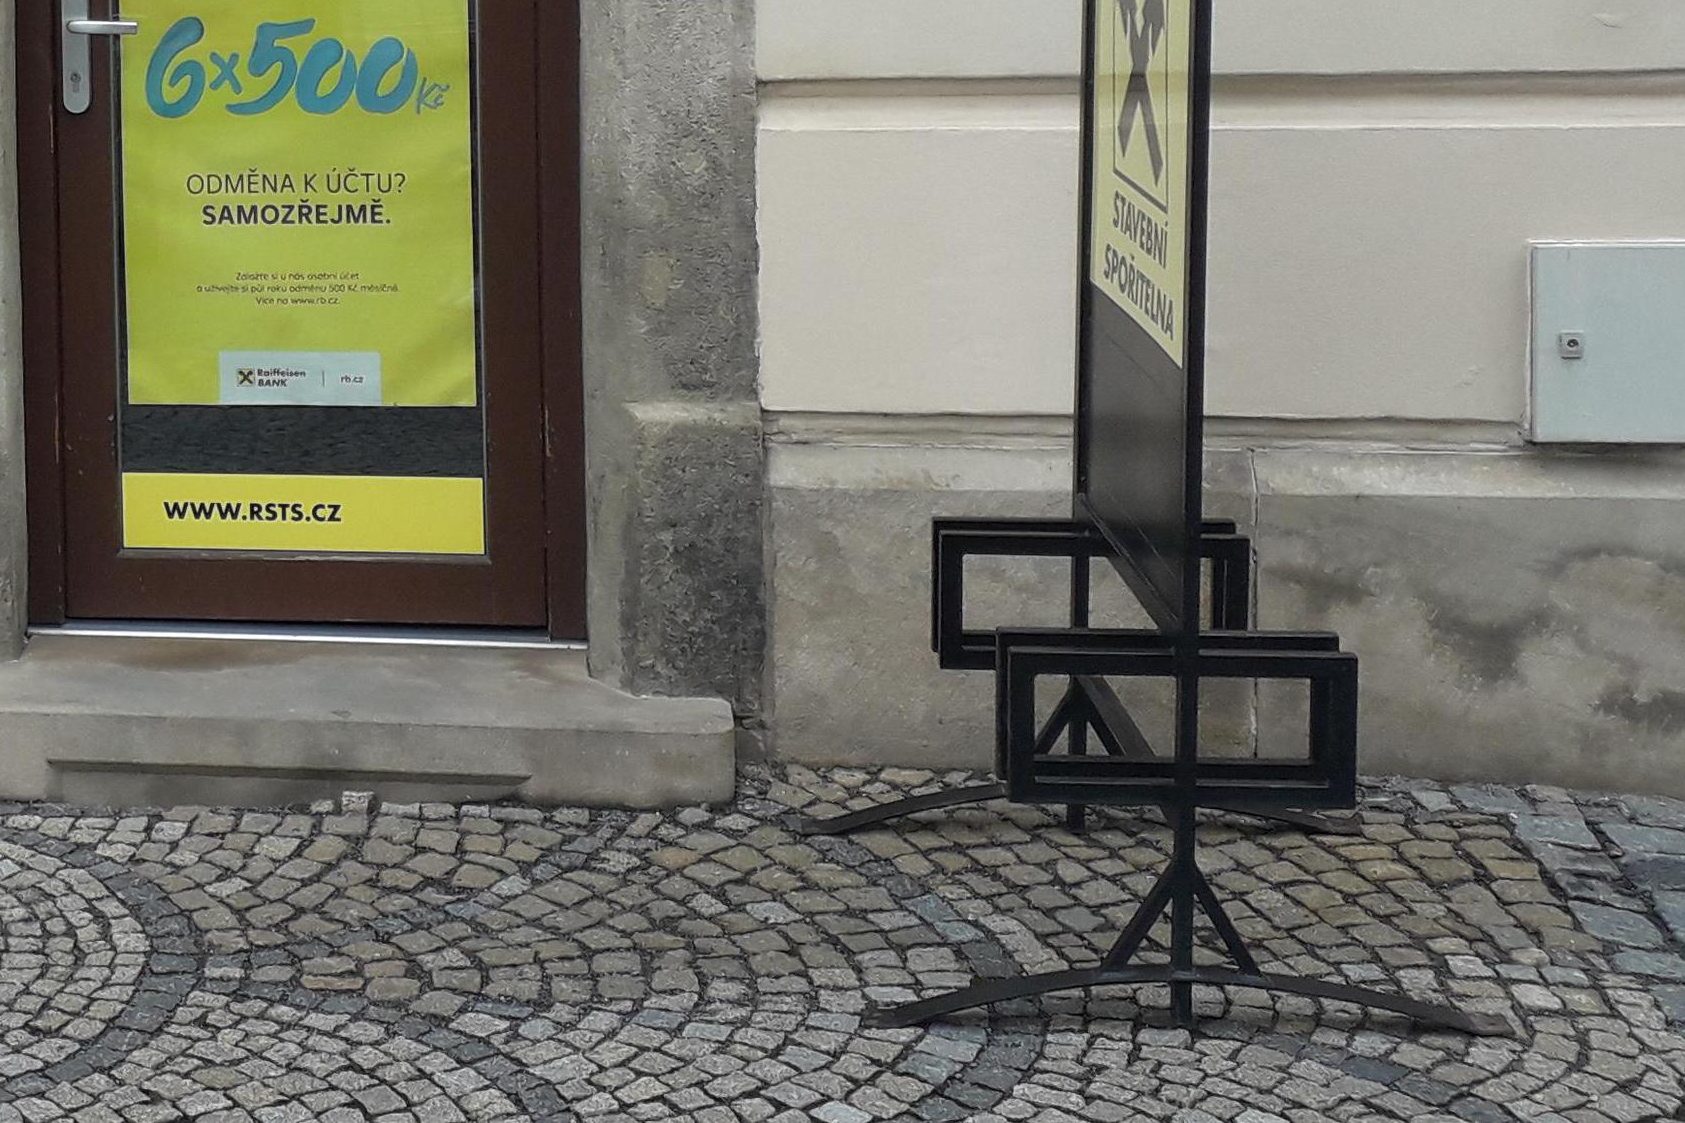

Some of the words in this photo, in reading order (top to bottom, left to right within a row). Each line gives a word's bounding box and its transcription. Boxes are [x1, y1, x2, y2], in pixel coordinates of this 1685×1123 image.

[186, 168, 295, 195] ODMĚNA
[304, 173, 319, 193] K
[326, 167, 406, 194] ÚČTU?
[202, 198, 391, 225] SAMOZŘEJMĚ.
[1112, 190, 1168, 269] STAVEBNÍ
[329, 283, 346, 292] 500
[1103, 243, 1174, 341] SPOŘITELNA
[257, 368, 306, 378] Raiffeisen
[258, 378, 288, 387] BANK
[340, 374, 364, 384] rb.cz
[163, 501, 343, 523] WWW.RSTS.CZ
